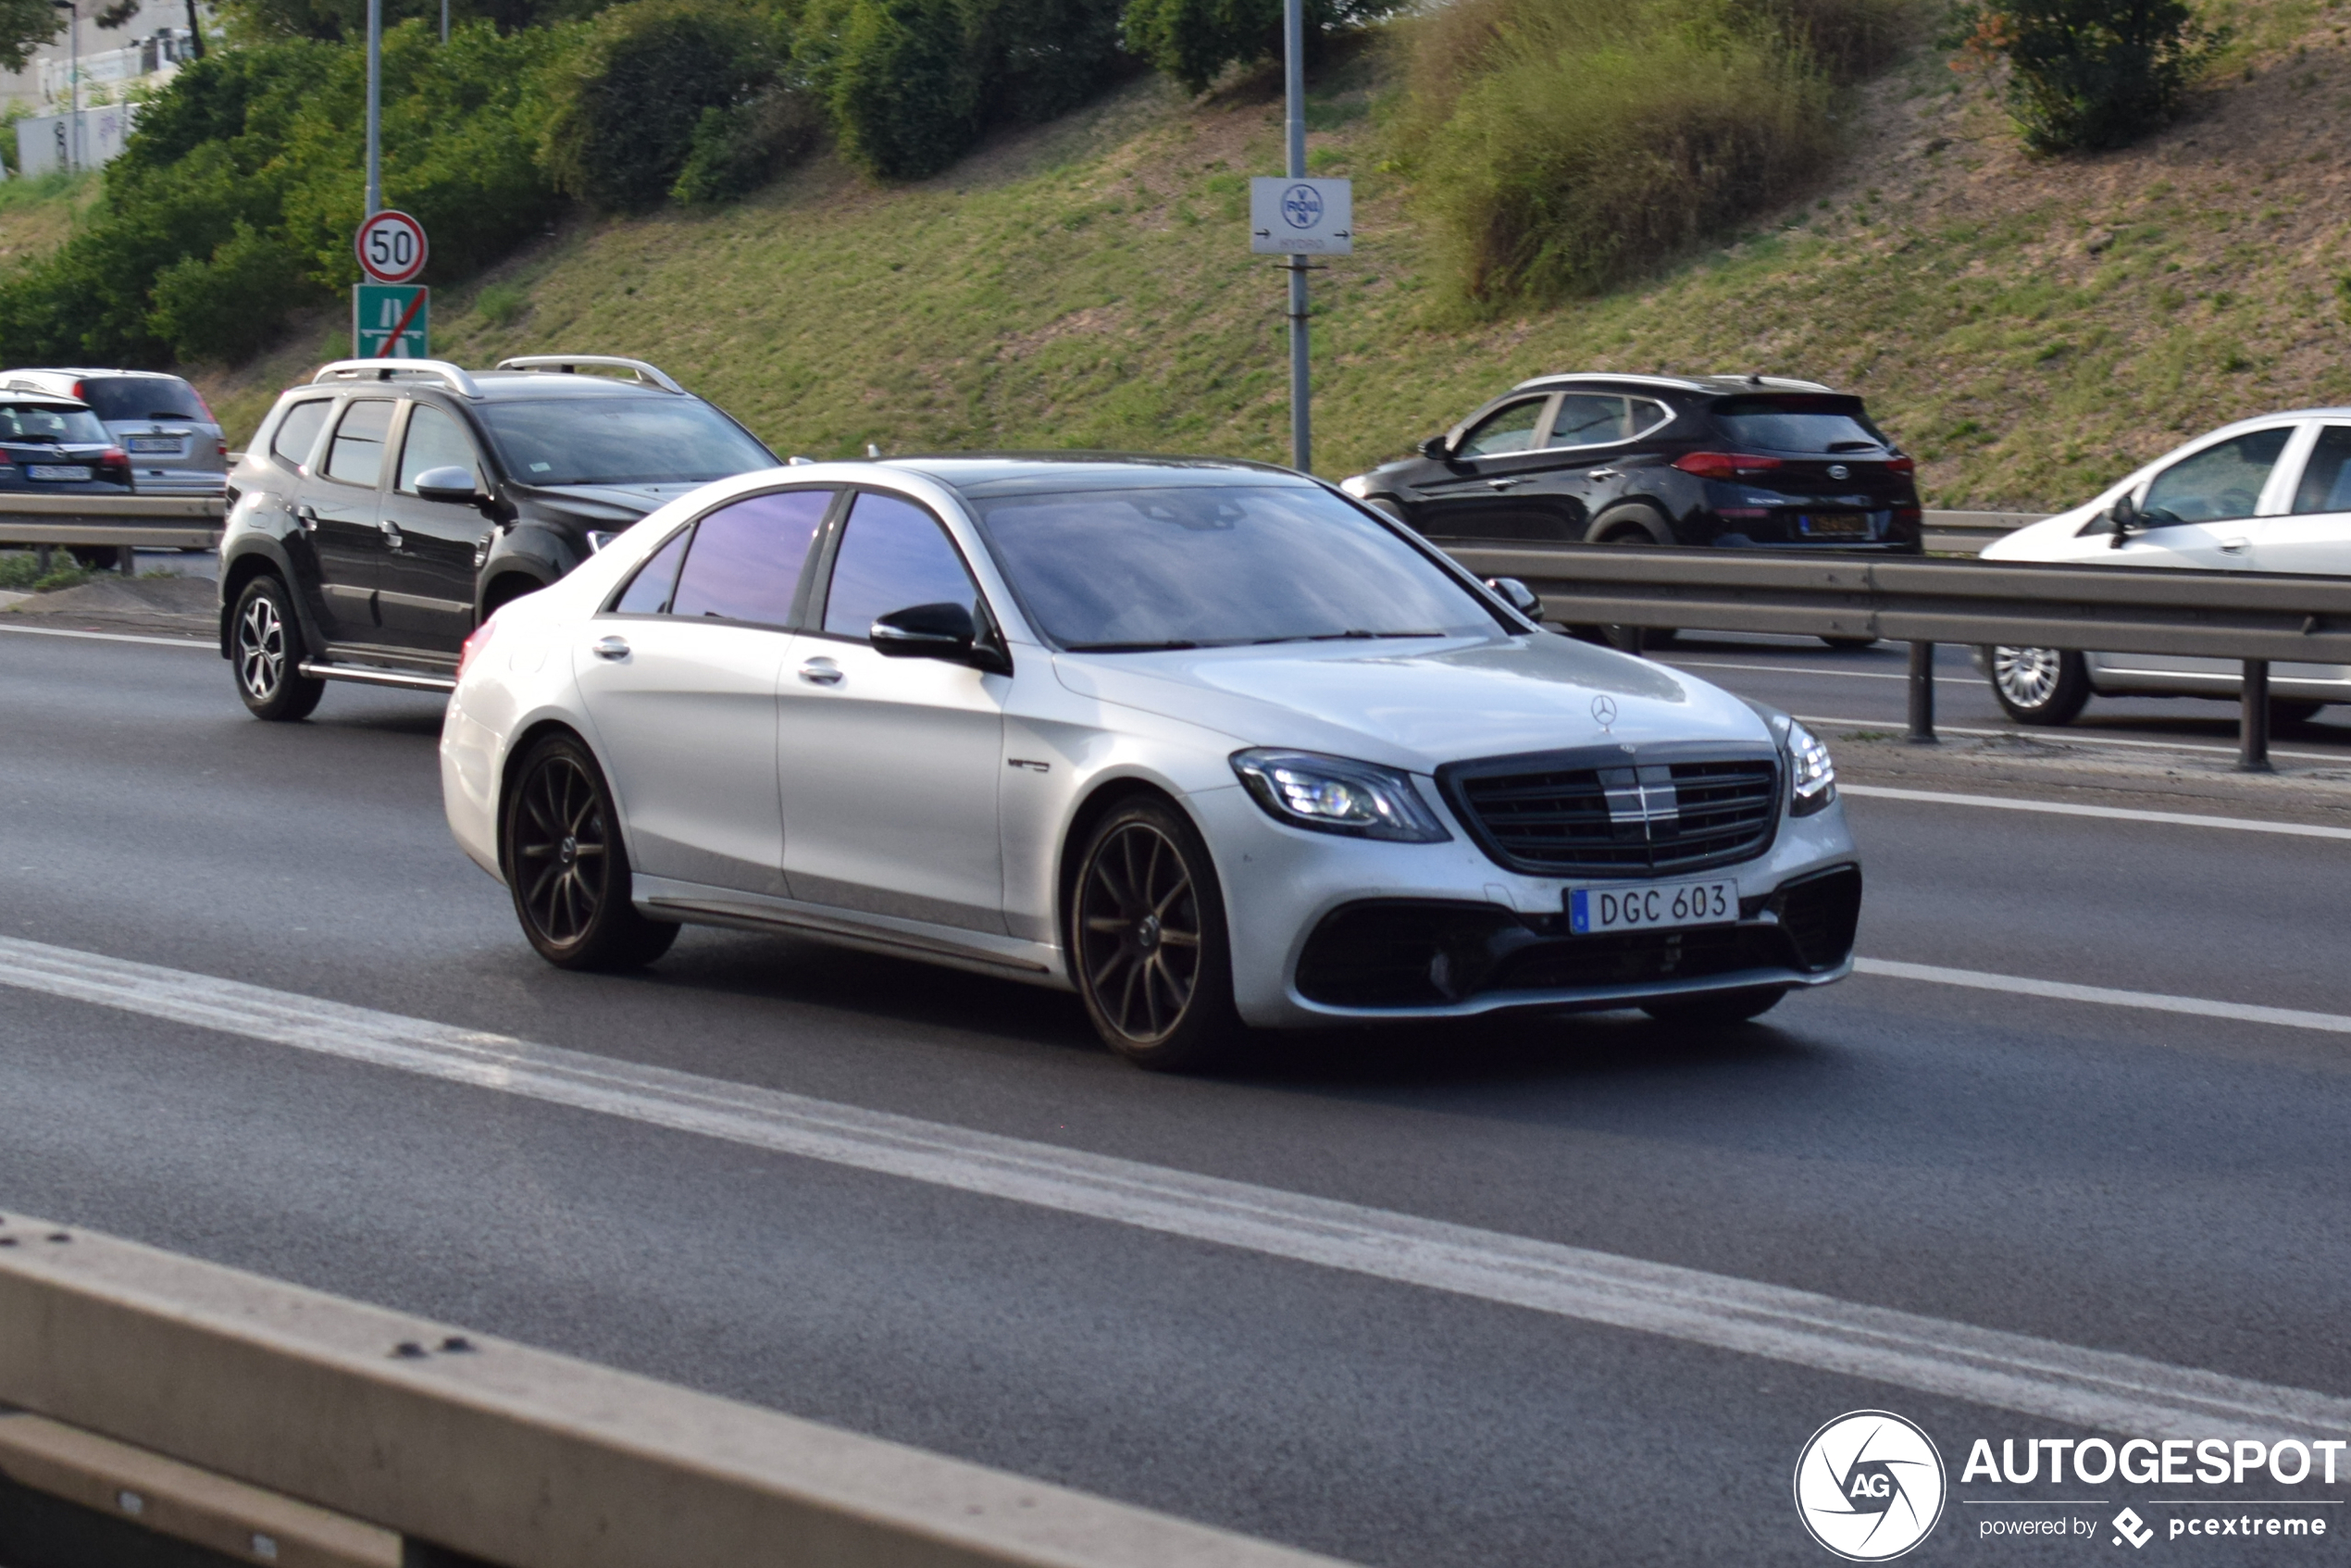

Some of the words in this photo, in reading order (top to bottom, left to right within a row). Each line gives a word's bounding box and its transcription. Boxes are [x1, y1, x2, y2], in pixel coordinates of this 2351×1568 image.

[372, 230, 411, 265] 50
[1600, 890, 1660, 926] DGC
[1672, 885, 1726, 919] 603
